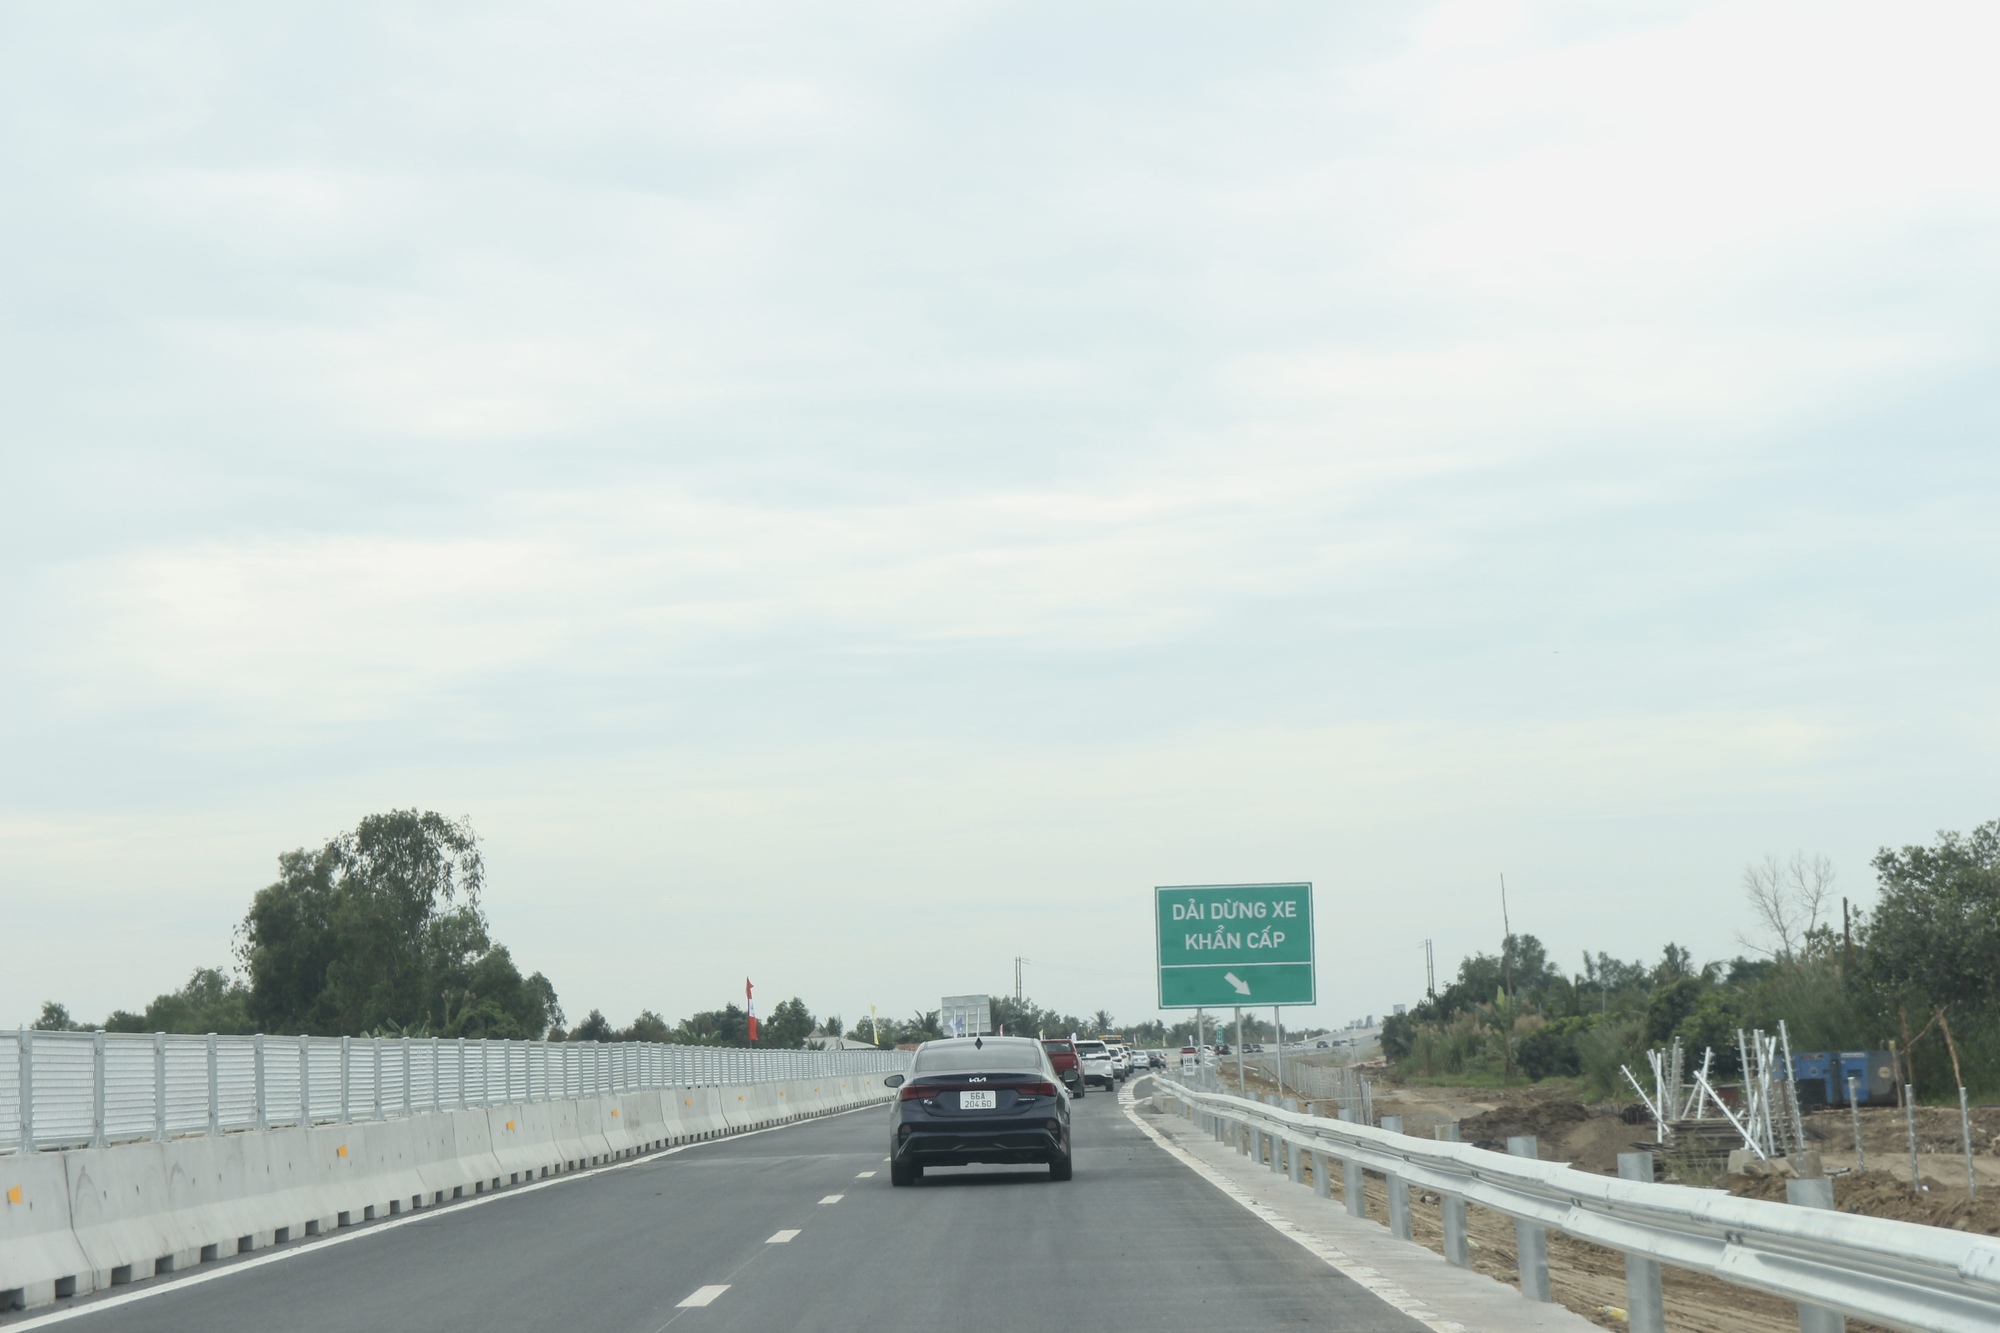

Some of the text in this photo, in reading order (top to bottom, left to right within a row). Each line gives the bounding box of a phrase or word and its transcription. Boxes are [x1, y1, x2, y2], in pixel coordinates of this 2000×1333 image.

[1172, 898, 1297, 920] DẢI DỪNG XE
[1185, 924, 1286, 950] KHẨN CẤP
[970, 1092, 985, 1100] 66A
[964, 1100, 992, 1108] 204.60
